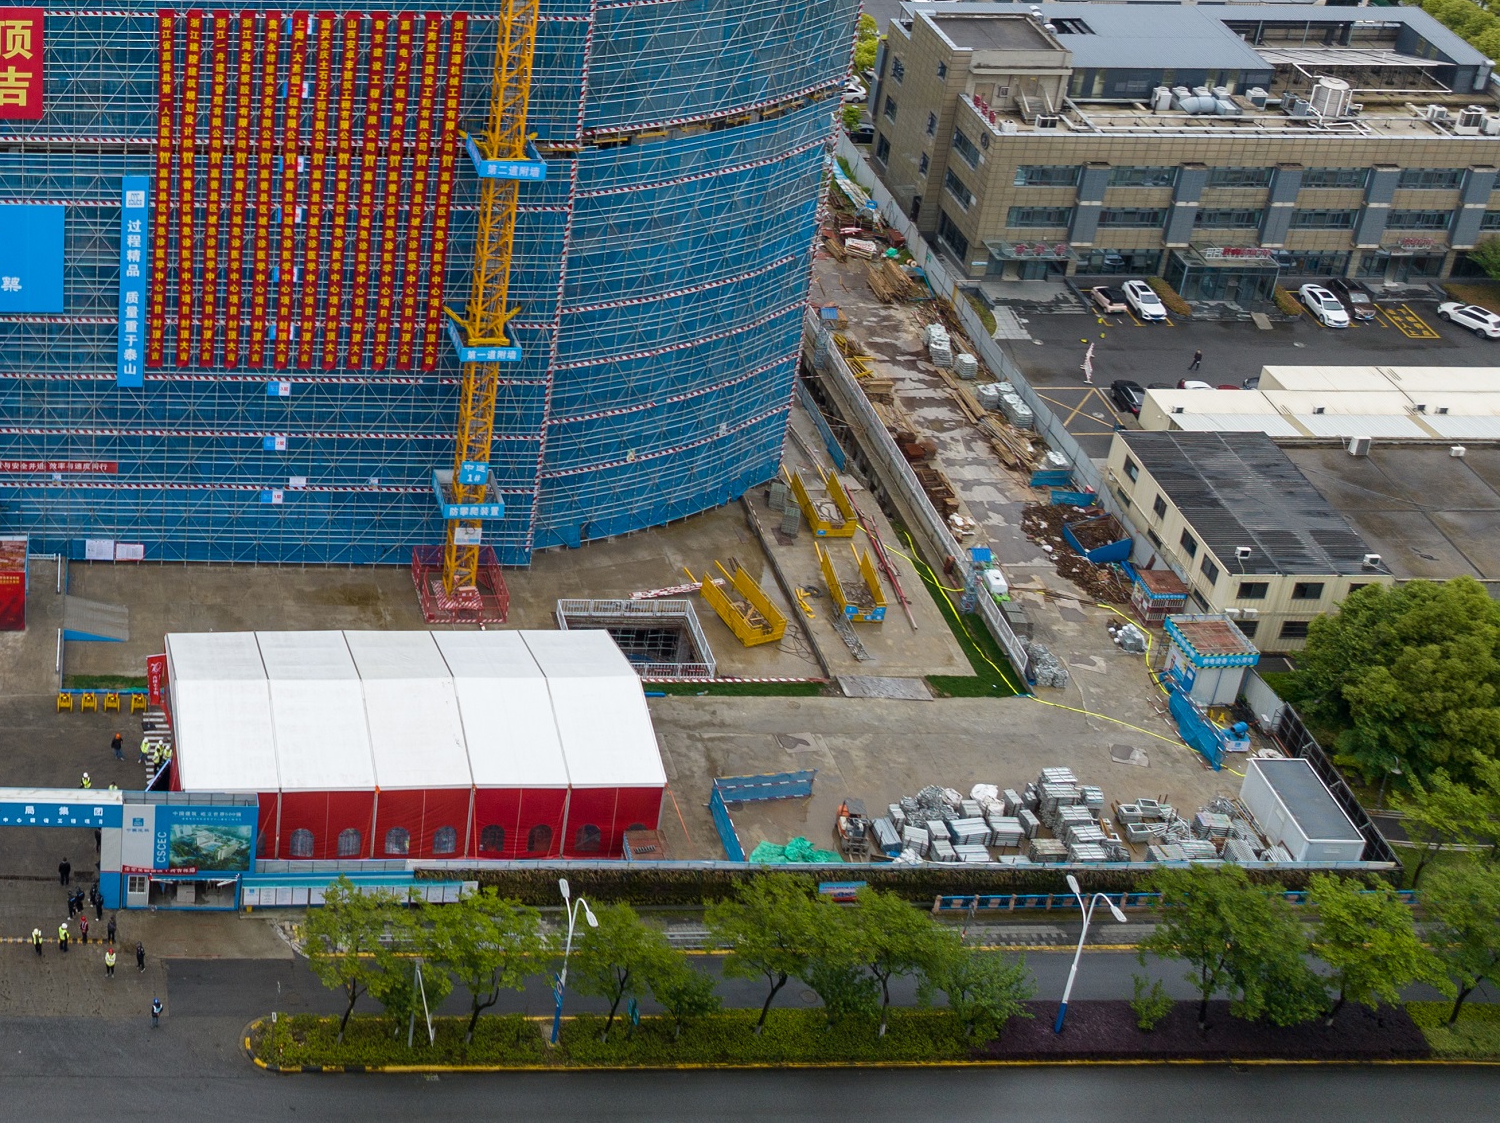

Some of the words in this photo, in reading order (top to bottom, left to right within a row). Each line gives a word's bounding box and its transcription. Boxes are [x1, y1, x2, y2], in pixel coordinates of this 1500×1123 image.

[486, 163, 541, 178] 第二道附墙
[125, 219, 142, 278] 过程精品
[123, 290, 140, 376] 质量重于泰山
[466, 349, 517, 361] 第一道附墙
[466, 473, 481, 483] 1#
[156, 831, 167, 863] CSCEC
